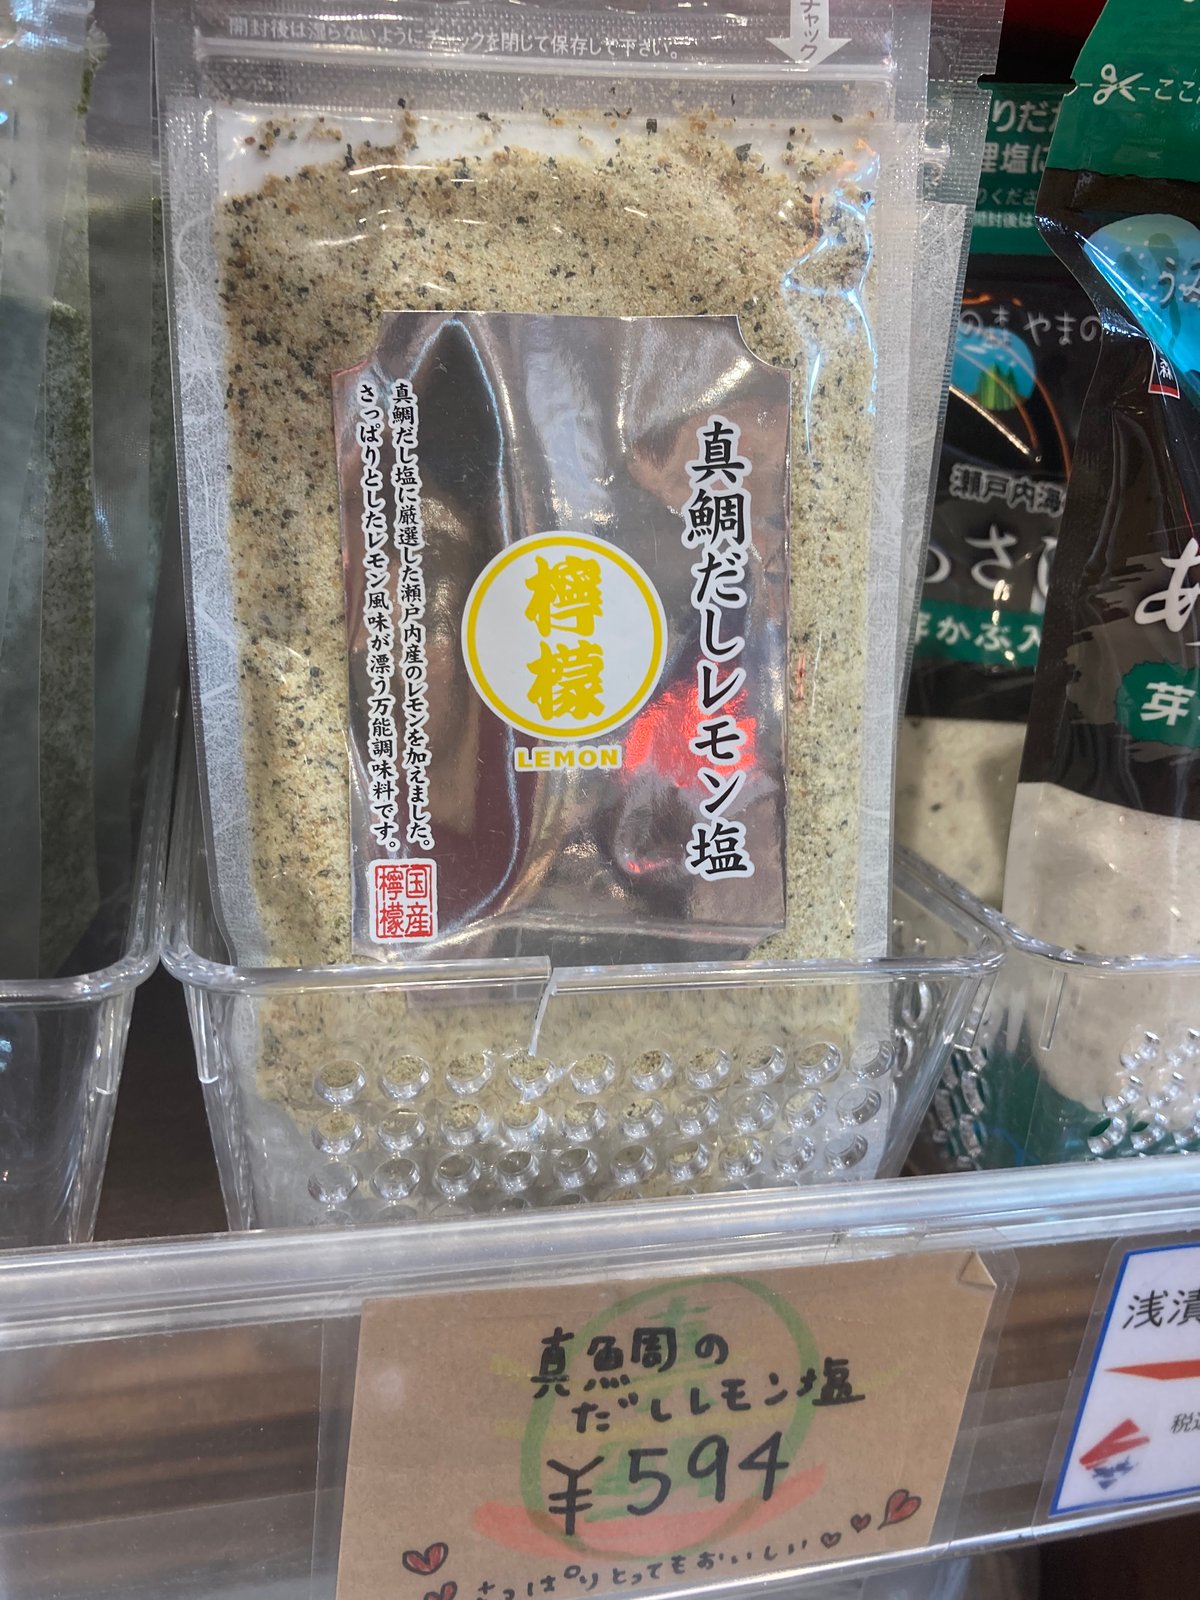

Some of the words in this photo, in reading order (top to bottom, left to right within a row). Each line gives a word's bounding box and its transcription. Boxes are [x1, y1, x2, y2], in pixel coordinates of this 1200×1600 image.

[799, 0, 821, 61] チャック
[1154, 78, 1200, 104] ここ
[359, 383, 397, 848] さっぱりとしたレモン風味が漂う万能調味料です。
[391, 382, 431, 847] 真鯛だし塩に厳選した瀬戸内産のレモンを加えました。
[525, 555, 606, 720] 檸檬
[687, 420, 749, 876] 真鯛だしレモン塩
[515, 748, 620, 769] LEMON
[1170, 1411, 1200, 1434] 税
[546, 1431, 790, 1536] ¥594
